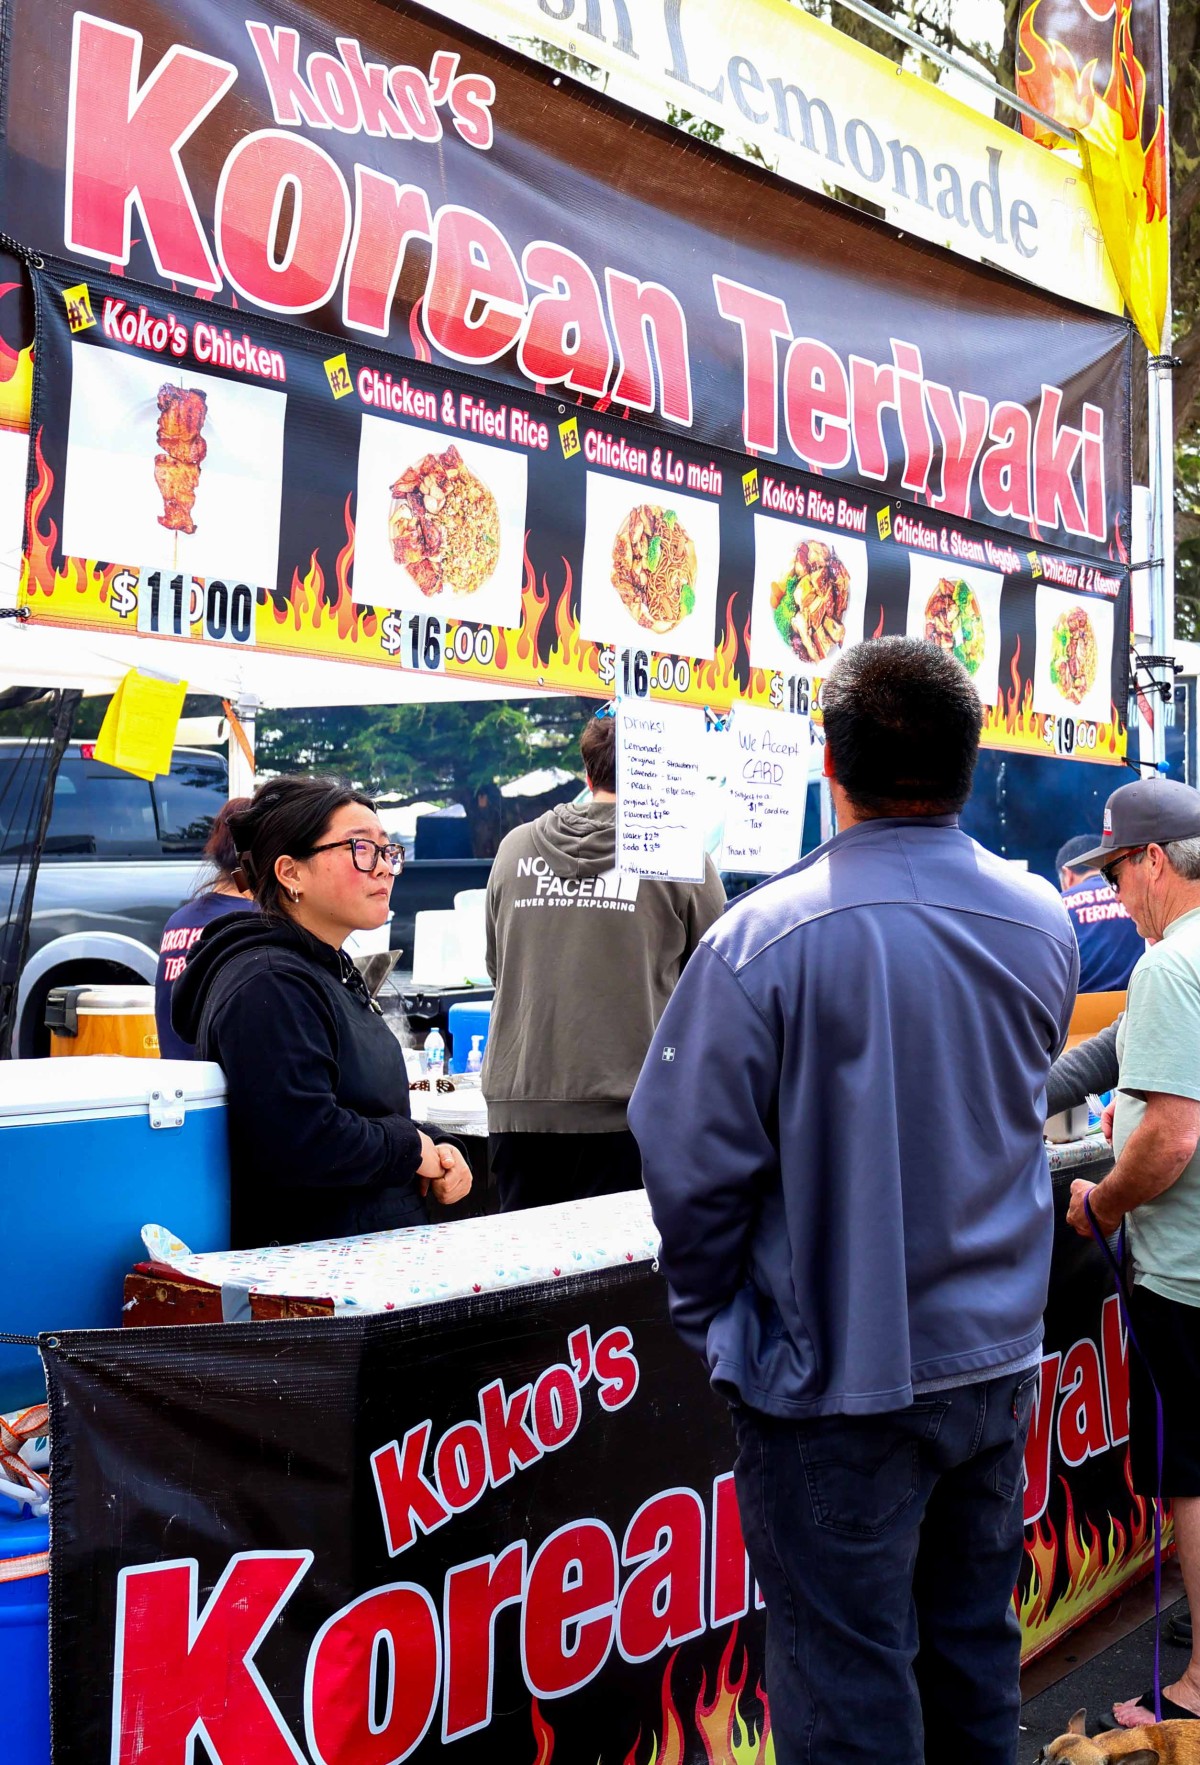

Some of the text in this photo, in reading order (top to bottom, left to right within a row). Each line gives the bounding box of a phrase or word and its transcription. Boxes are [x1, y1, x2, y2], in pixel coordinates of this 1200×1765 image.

[245, 20, 496, 150] Koko's
[664, 0, 1039, 259] Lemonade
[64, 11, 1108, 543] Korean Teriyaki
[66, 293, 96, 330] #1
[102, 299, 287, 382] Koko's Chicken
[330, 367, 351, 393] #2
[357, 367, 549, 451] Chicken & Fried Rice
[562, 430, 578, 454] #3
[584, 428, 723, 496] Chicken & Lo mein
[744, 479, 760, 501] #4
[761, 476, 867, 532] Koko's Rice Bowl
[879, 515, 891, 536] #5
[893, 514, 938, 550] Chicken
[940, 528, 950, 549] &
[950, 530, 986, 562] Steam
[1042, 556, 1120, 597] Chicken & 2 Items
[380, 611, 494, 669] $16.00
[599, 646, 690, 698] $16.00
[738, 730, 800, 756] We Accept
[742, 758, 784, 784] CARD
[514, 898, 636, 912] NEVER STOP EXPLORING
[536, 876, 596, 899] FACE
[1075, 902, 1131, 924] TERIYAK
[370, 1324, 640, 1557] Koko's
